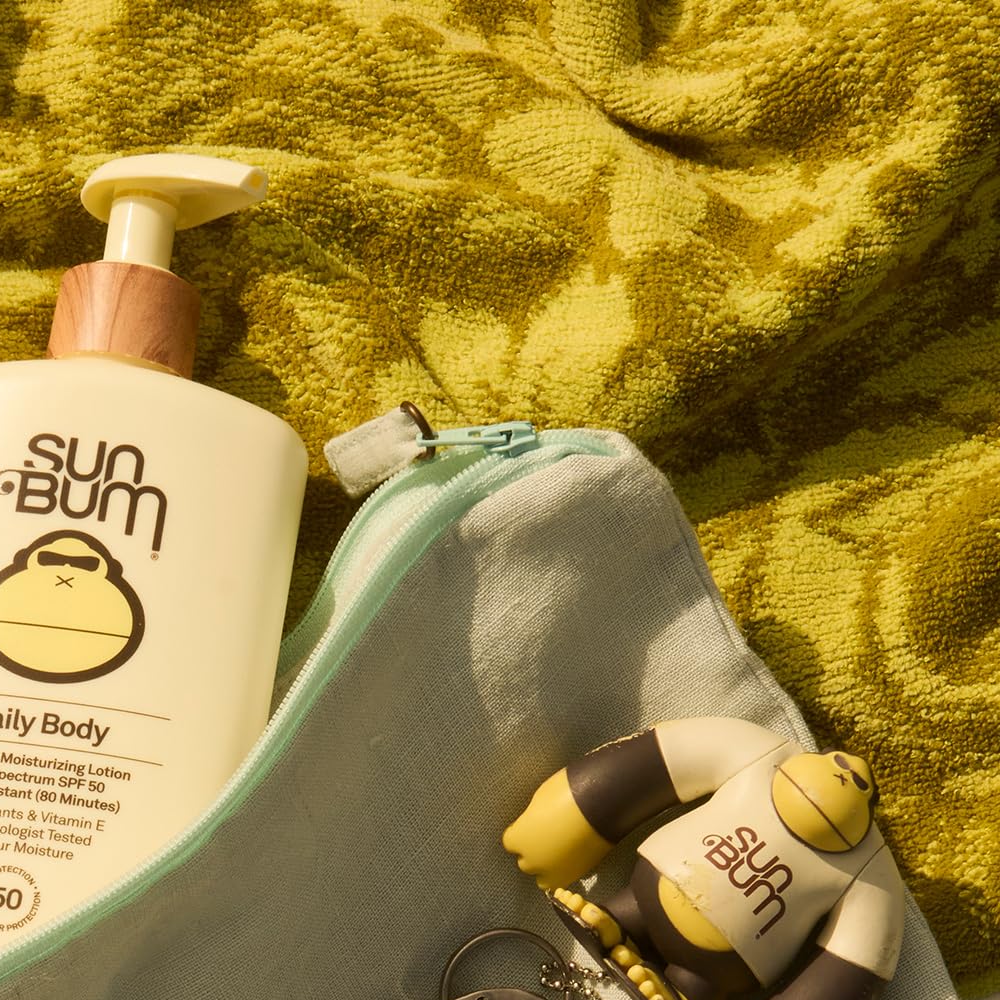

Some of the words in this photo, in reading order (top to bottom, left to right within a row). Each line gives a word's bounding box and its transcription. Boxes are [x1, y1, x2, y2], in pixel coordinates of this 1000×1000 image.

[41, 712, 110, 747] Body
[0, 752, 86, 777] Moisturizing
[88, 763, 131, 781] Lotion
[58, 776, 87, 790] SPF
[88, 780, 105, 793] 50
[35, 789, 57, 803] (80
[59, 793, 120, 815] Minutes)
[27, 809, 38, 822] &
[41, 811, 92, 829] Vitamin
[96, 819, 106, 832] E
[48, 829, 92, 846] Tested
[13, 841, 74, 860] Moisture
[6, 891, 41, 931] PROTECTION
